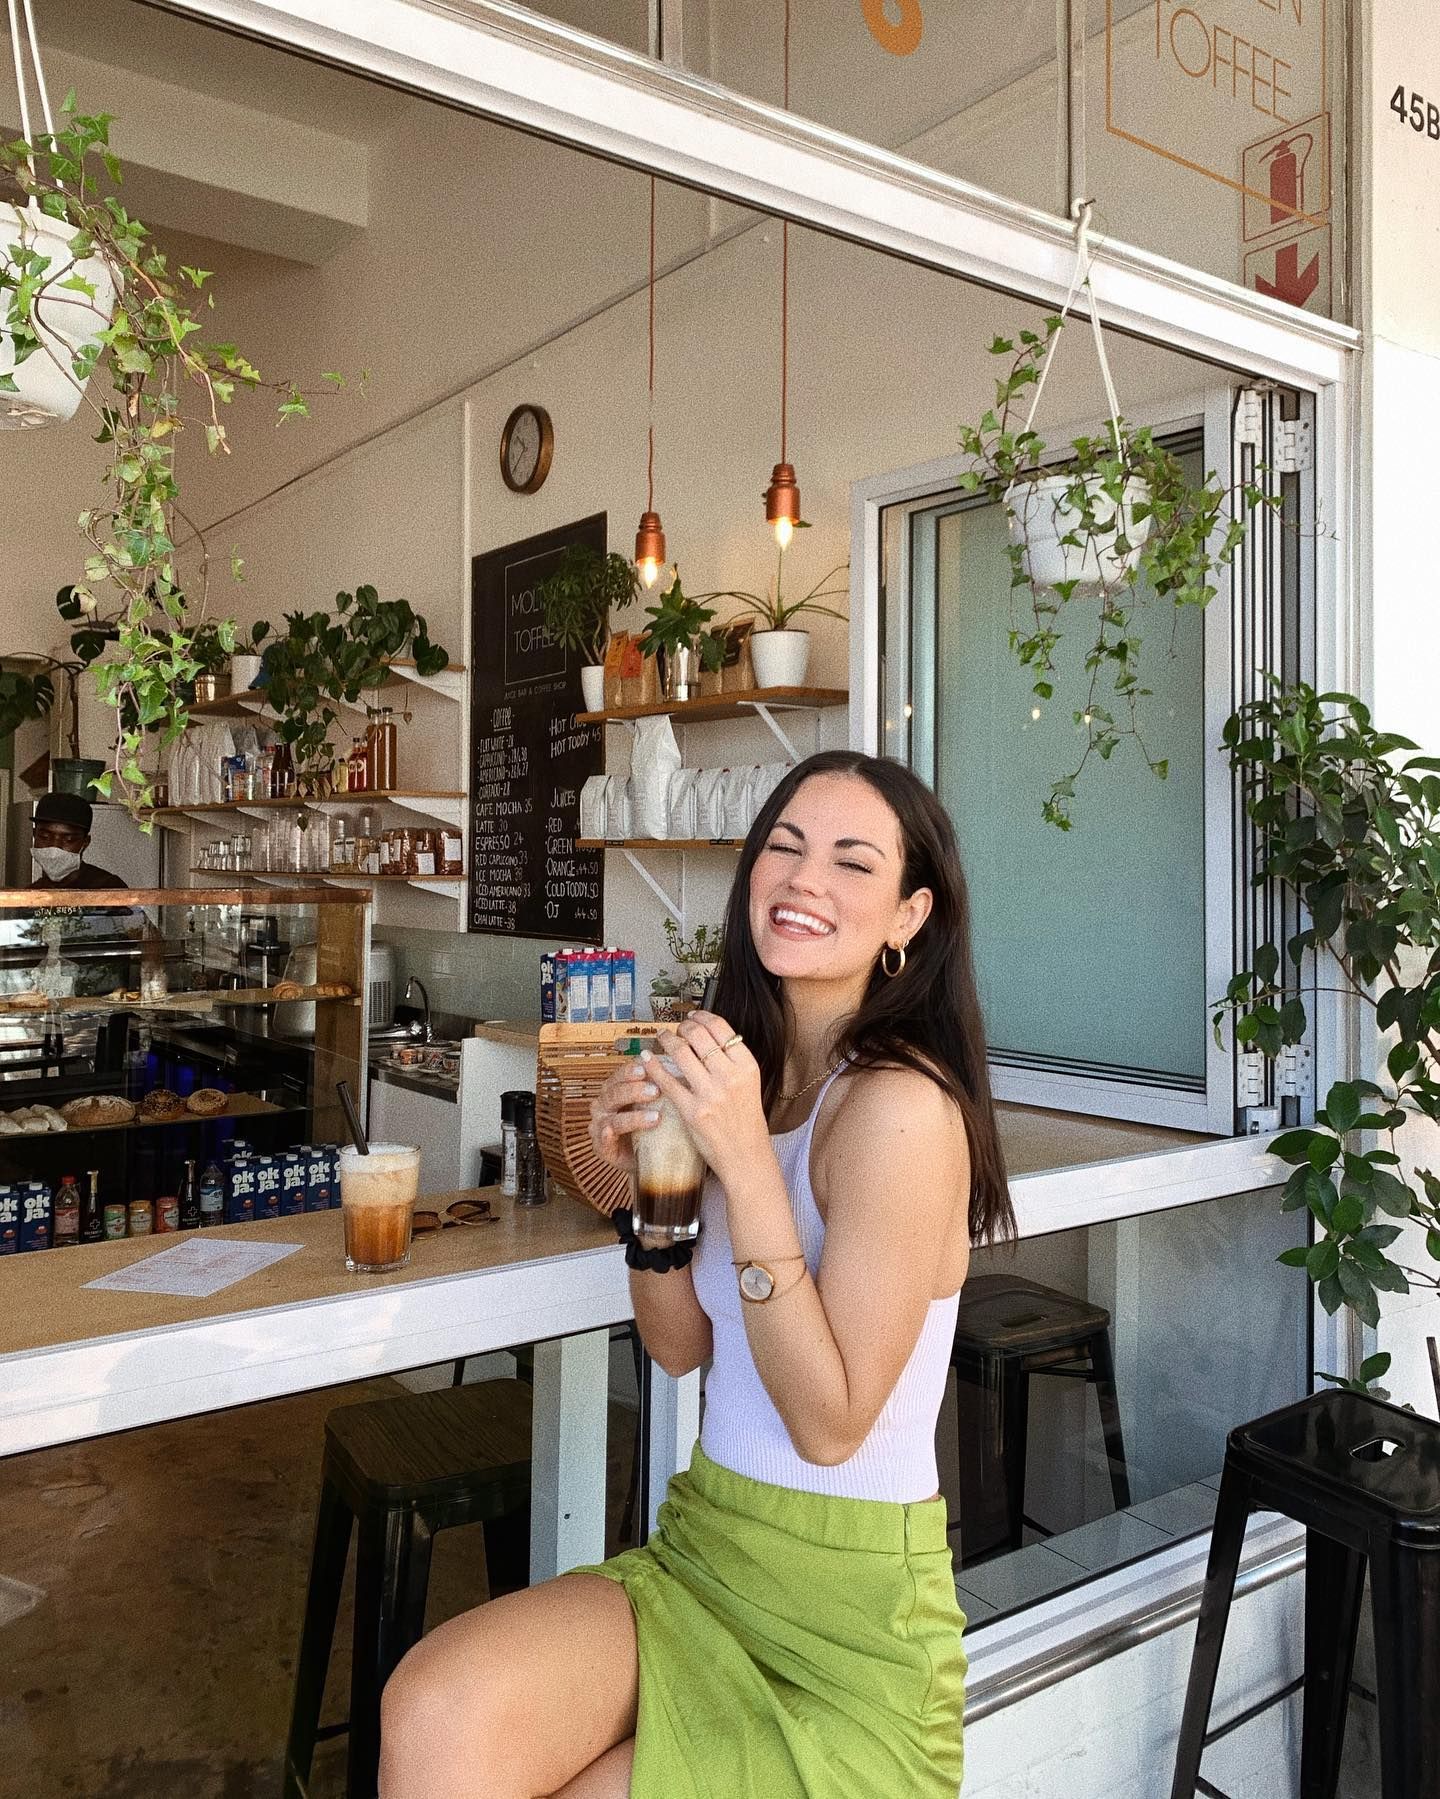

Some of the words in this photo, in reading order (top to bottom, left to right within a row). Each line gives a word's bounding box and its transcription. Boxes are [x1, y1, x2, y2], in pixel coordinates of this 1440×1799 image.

[1156, 0, 1292, 125] TOFFEE
[1390, 84, 1440, 141] 45B
[550, 717, 567, 737] HOT
[550, 738, 566, 759] HOT
[567, 731, 590, 751] TODDY
[550, 787, 576, 809] JUICES
[475, 802, 494, 817] CAFE
[495, 801, 522, 816] MOCHA
[475, 820, 494, 834] LATTE
[547, 817, 563, 833] RED
[475, 834, 510, 851] ESPRESSO
[546, 835, 573, 855] GREEN
[489, 868, 512, 882] MOCHA
[545, 857, 576, 877] ORANGE
[546, 880, 566, 898] COLD
[565, 881, 587, 898] TODDY
[257, 1167, 279, 1181] ok
[283, 1164, 305, 1178] ok
[309, 1161, 330, 1175] ok
[232, 1170, 254, 1185] ok
[284, 1176, 305, 1191] ja.
[309, 1173, 330, 1187] ja.
[232, 1183, 254, 1197] ja.
[258, 1179, 279, 1194] ja.
[24, 1194, 50, 1210] ok
[24, 1208, 50, 1223] ja.
